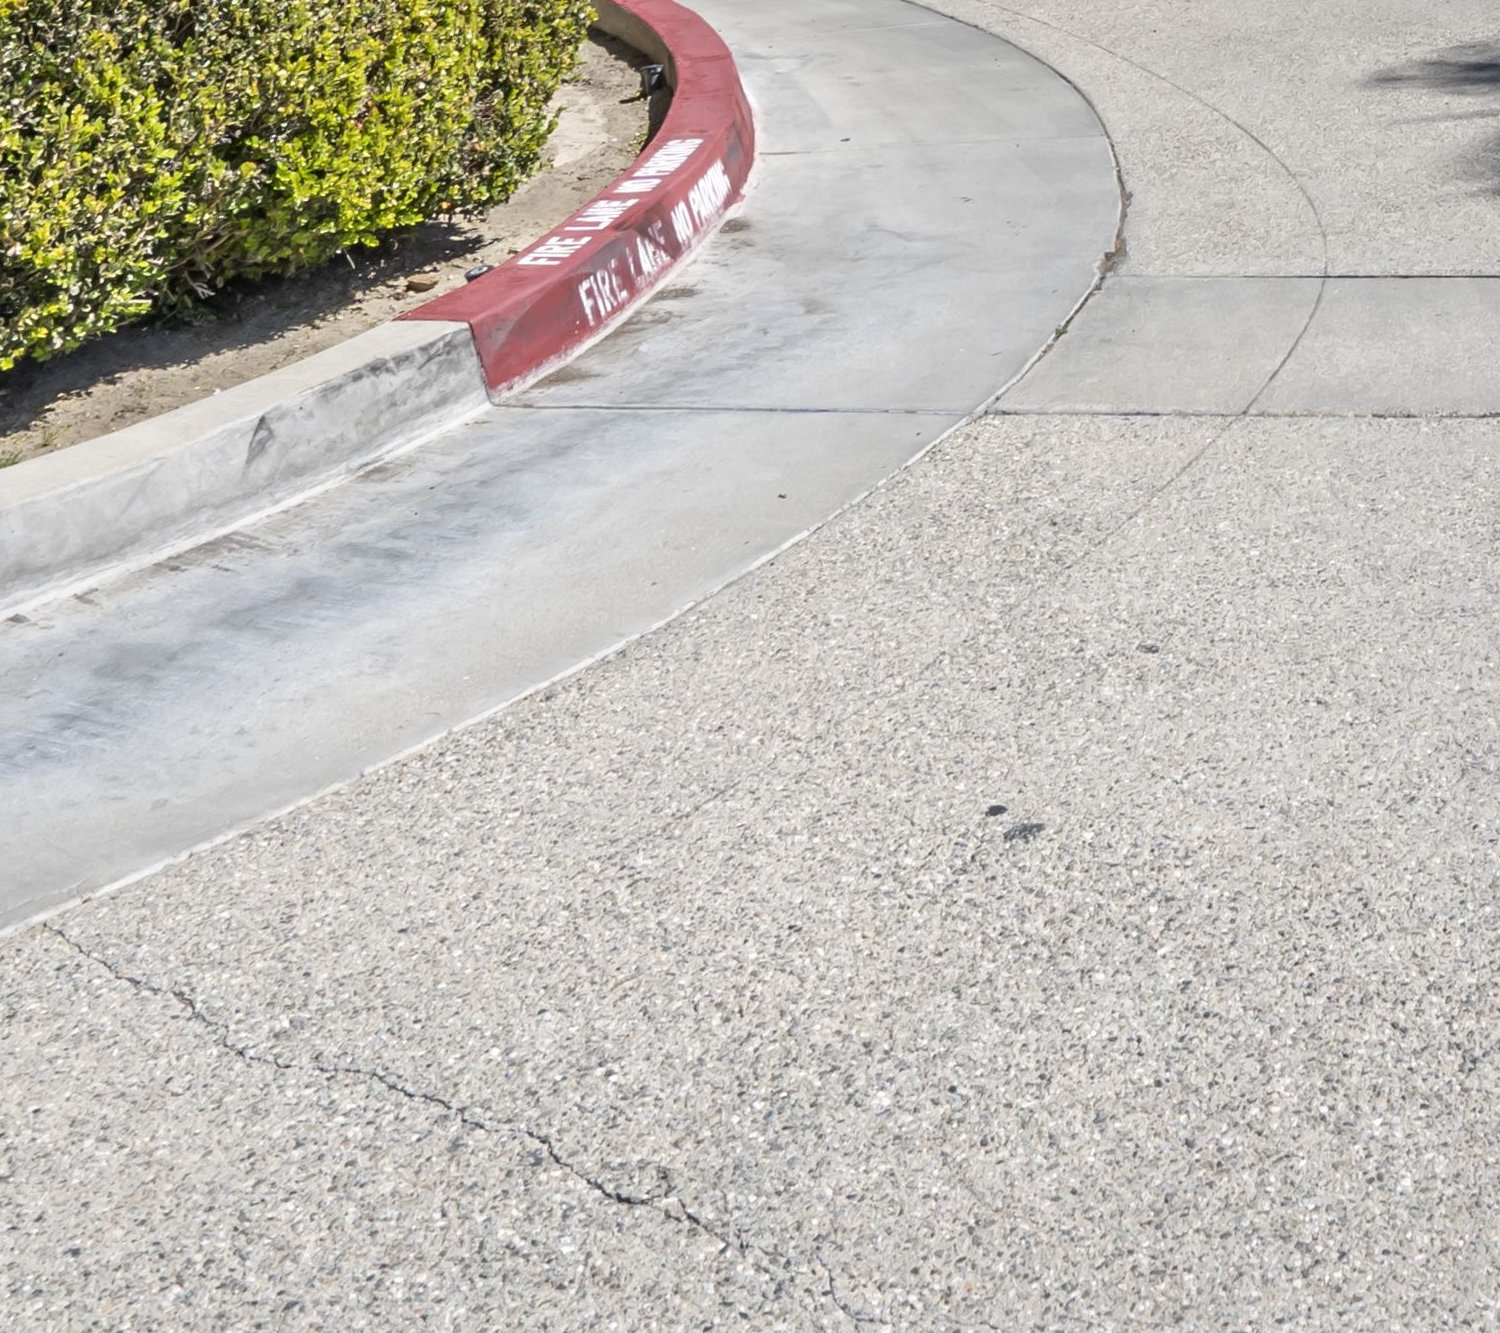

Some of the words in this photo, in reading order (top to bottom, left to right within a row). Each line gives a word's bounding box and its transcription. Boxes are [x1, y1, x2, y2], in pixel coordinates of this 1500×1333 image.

[631, 138, 705, 178] PARKING
[611, 178, 663, 194] NO
[564, 198, 640, 231] LANE
[516, 235, 593, 266] FIRE
[578, 257, 630, 327] FIRE
[669, 199, 694, 245] NO
